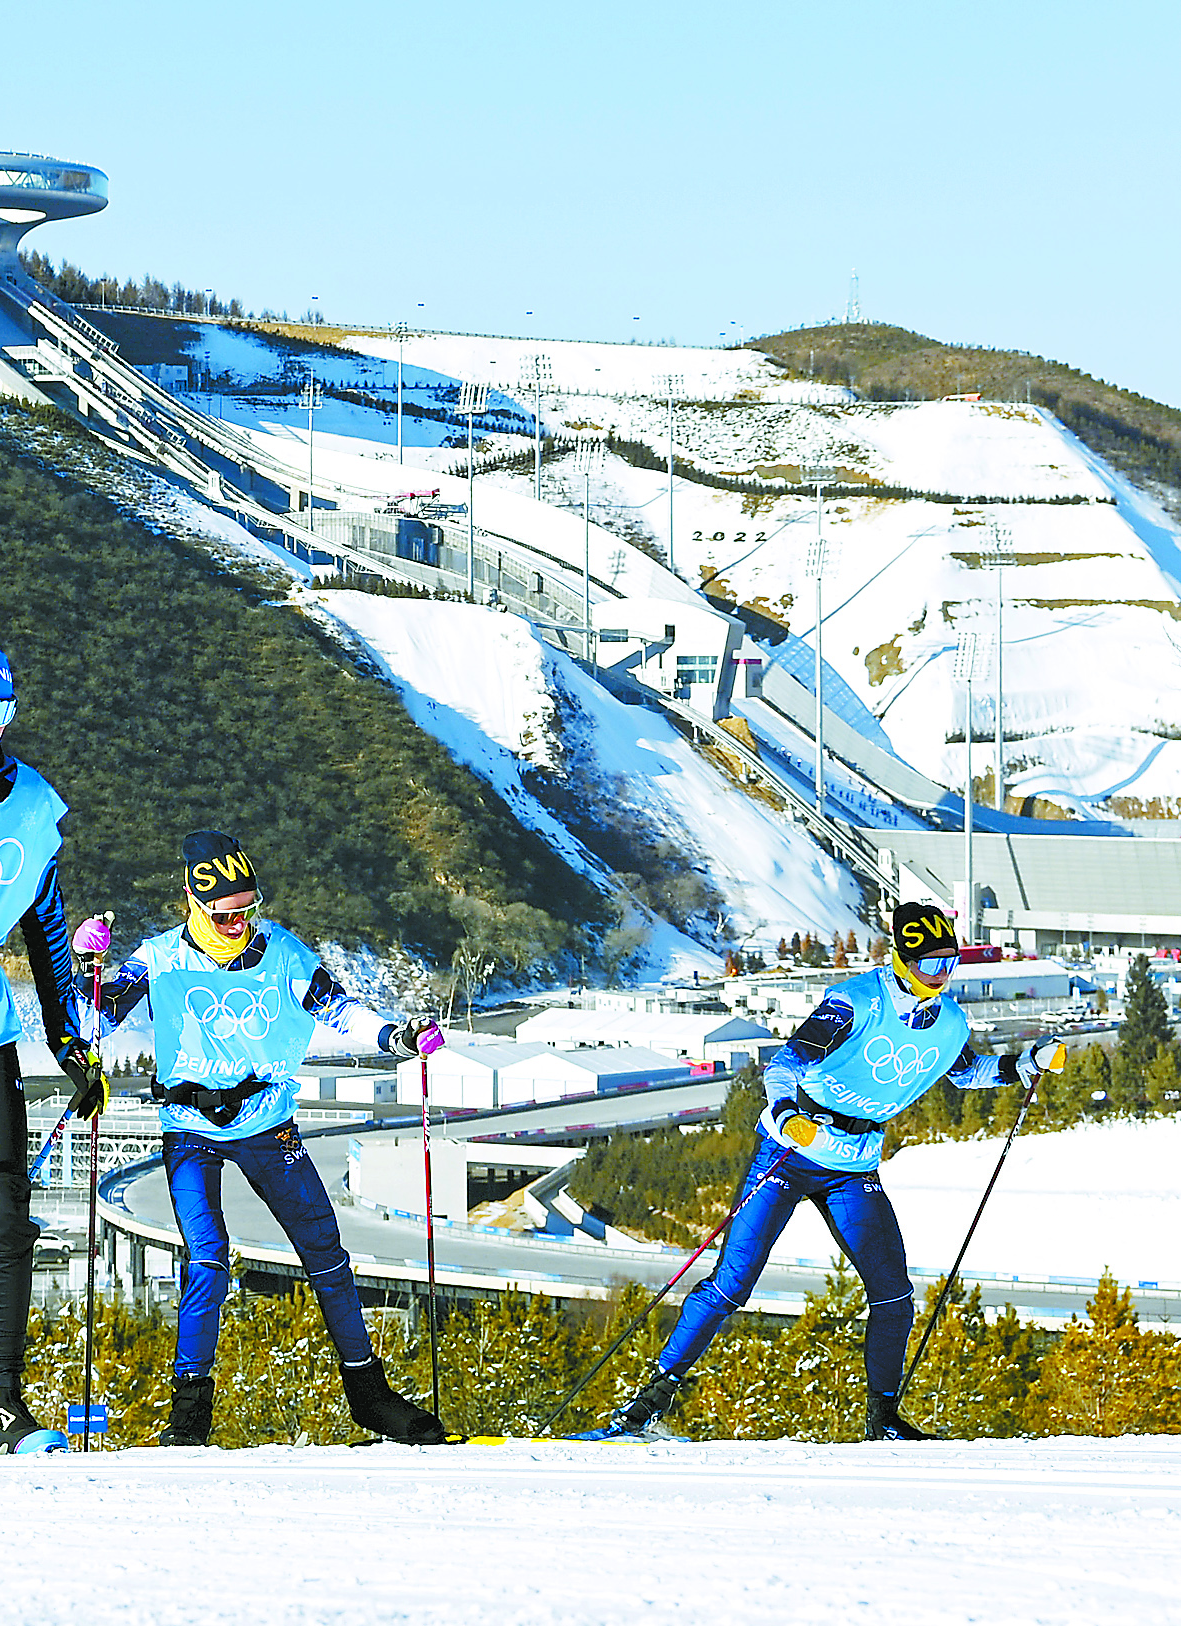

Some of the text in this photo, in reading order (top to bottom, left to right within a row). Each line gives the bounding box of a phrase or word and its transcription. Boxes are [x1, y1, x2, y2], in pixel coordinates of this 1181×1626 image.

[692, 531, 767, 542] 2022
[192, 850, 253, 892] SW
[175, 1050, 248, 1078] BEIJING
[823, 1074, 881, 1114] BEIJING
